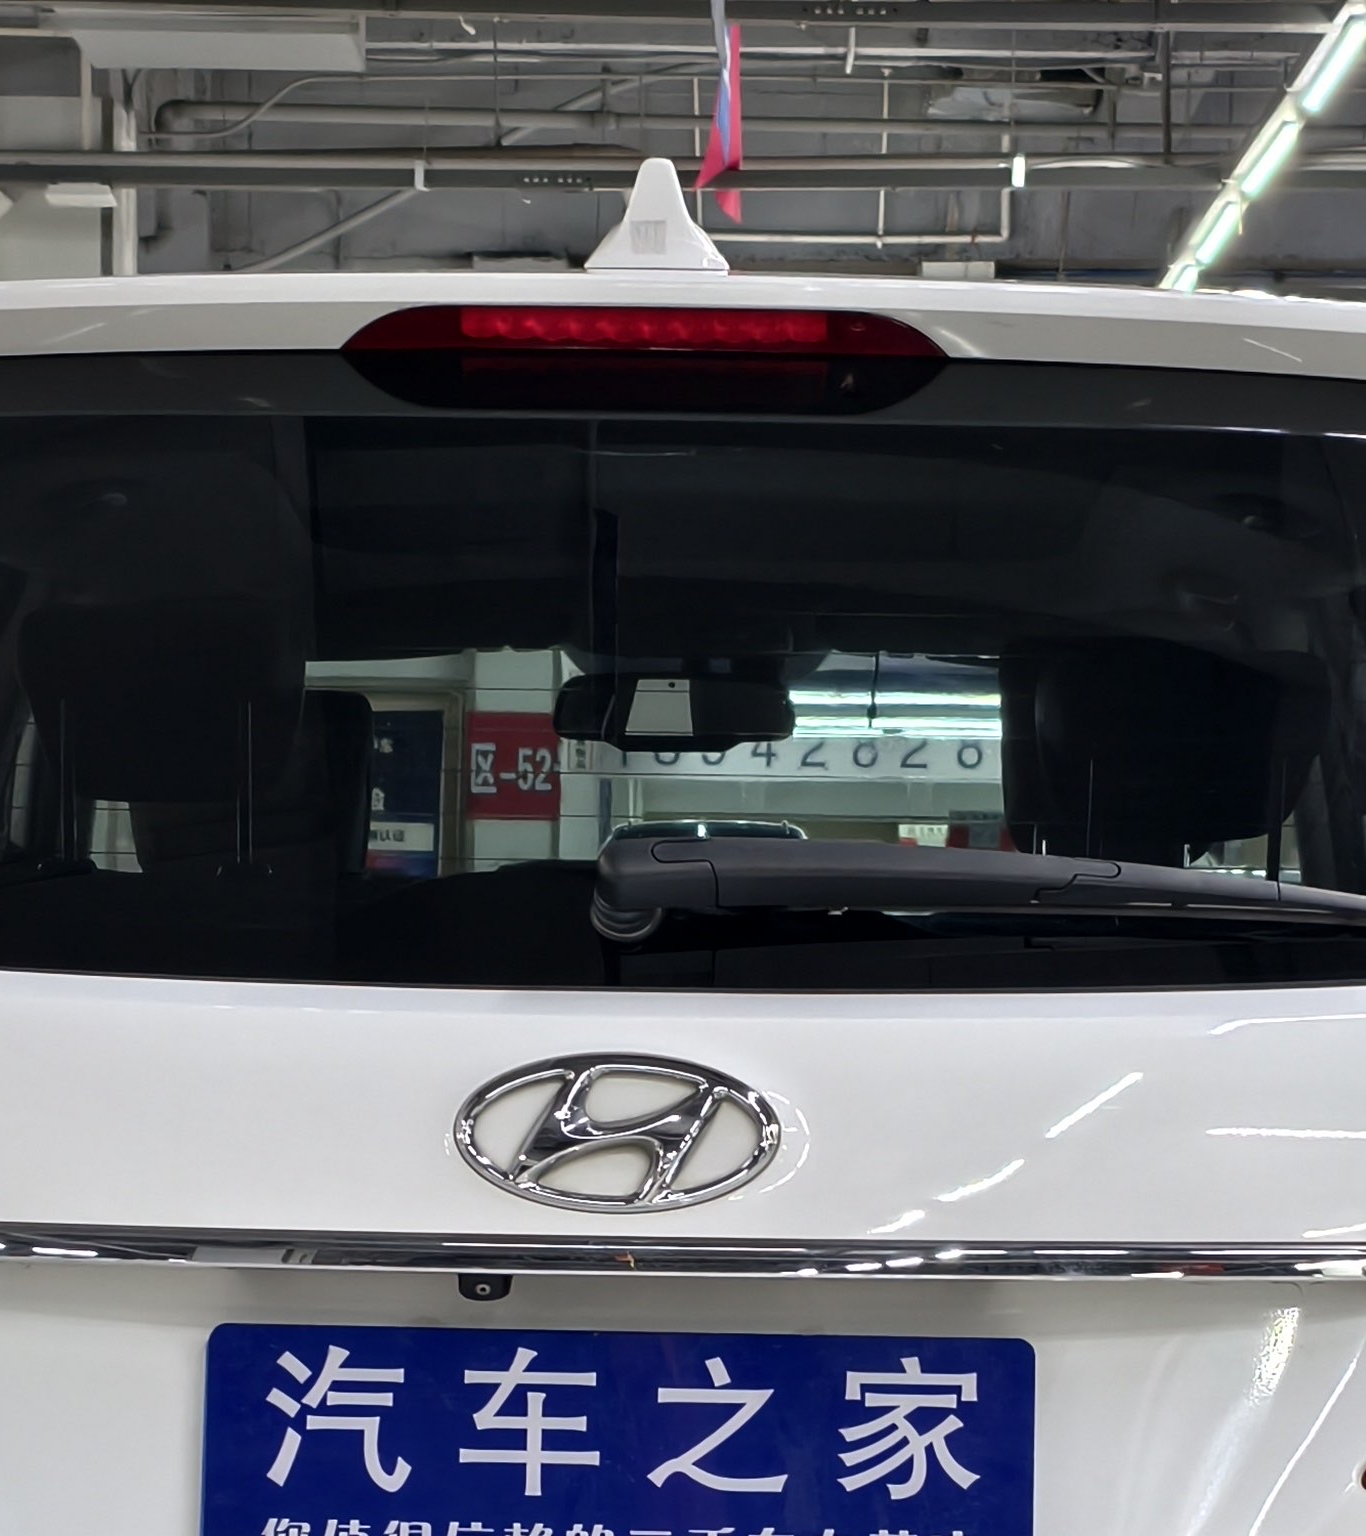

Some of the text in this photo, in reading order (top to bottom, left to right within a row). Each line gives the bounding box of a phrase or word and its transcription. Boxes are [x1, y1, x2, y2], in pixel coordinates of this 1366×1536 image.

[471, 742, 560, 794] 区-52
[265, 1345, 982, 1501] 汽车之家
